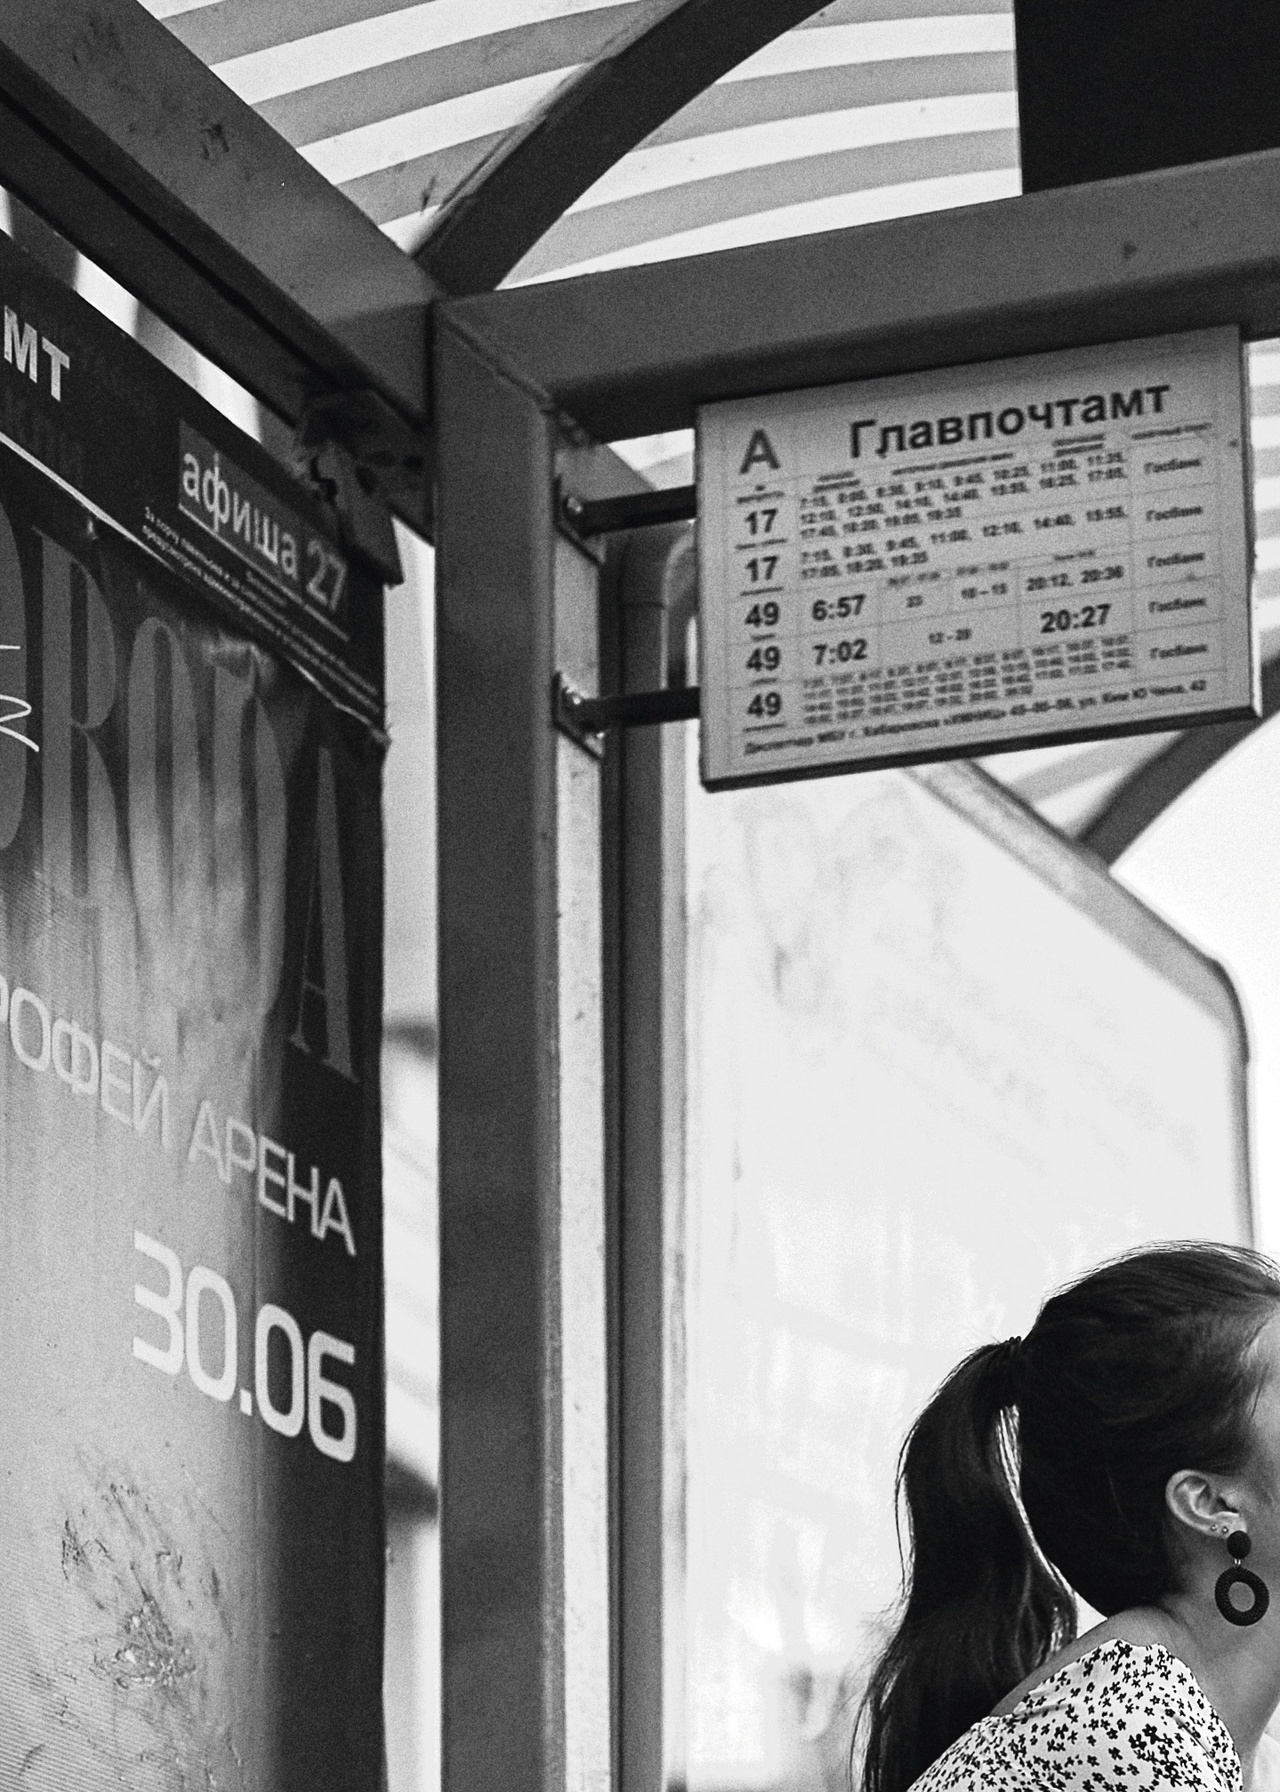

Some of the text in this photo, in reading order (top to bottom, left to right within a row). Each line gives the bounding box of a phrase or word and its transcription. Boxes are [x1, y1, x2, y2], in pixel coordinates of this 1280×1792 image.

[848, 384, 1172, 459] Главпочтамт
[739, 429, 781, 475] А
[182, 452, 298, 582] афиша
[306, 539, 347, 612] 27
[744, 507, 779, 536] 17
[744, 555, 779, 583] 17
[744, 601, 780, 628] 49
[812, 593, 867, 621] 6:57
[1040, 603, 1112, 634] 20:27
[745, 645, 781, 672] 49
[812, 638, 867, 666] 7:02
[746, 691, 782, 718] 49
[0, 974, 356, 1257] ОФЕЙ АРЕНА
[132, 1230, 356, 1463] 30.06
